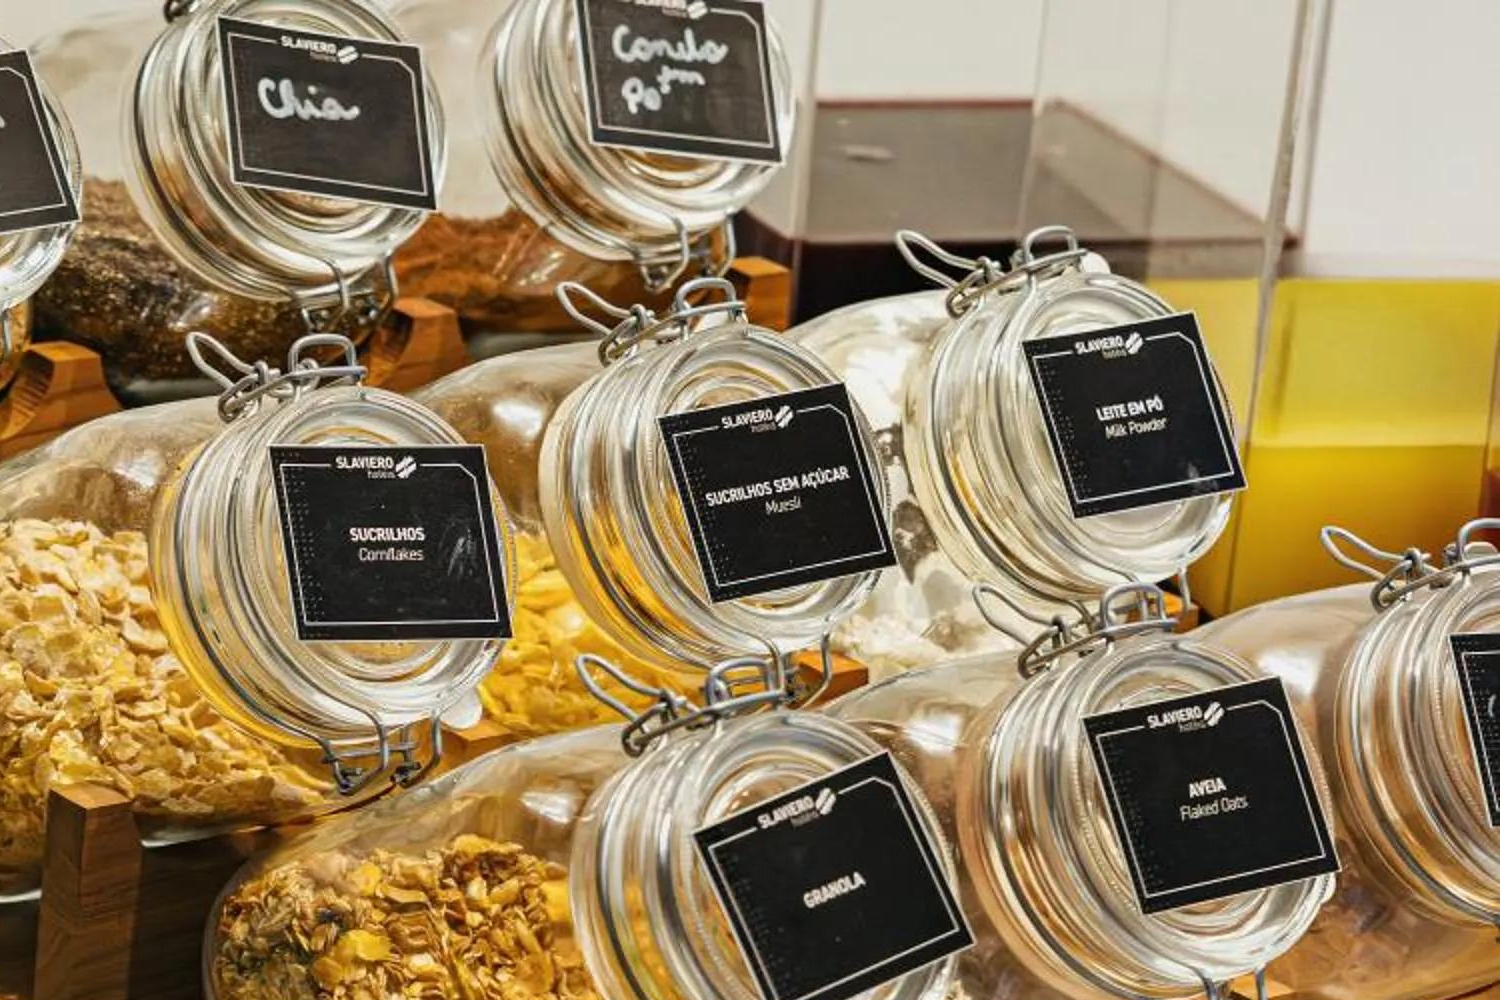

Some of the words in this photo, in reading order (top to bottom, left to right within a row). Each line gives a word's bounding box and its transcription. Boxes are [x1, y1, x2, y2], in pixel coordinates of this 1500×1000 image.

[257, 77, 361, 121] Chia
[1075, 335, 1125, 355] SLAVIERO
[1096, 403, 1127, 421] LEITE
[1129, 399, 1145, 416] EM
[1146, 394, 1164, 413] PÓ
[721, 408, 774, 430] SLAVIERO
[1105, 423, 1127, 439] Milk
[1129, 417, 1167, 436] Powder
[335, 455, 395, 470] SLAVIERO
[705, 481, 771, 508] SUCRILHOS
[773, 475, 800, 496] SEM
[801, 466, 851, 490] AÇÚCAR
[349, 527, 426, 542] SUCRILHOS
[358, 547, 425, 562] Cornflakes
[1147, 705, 1203, 729] SLAVIERO
[1188, 777, 1227, 799] AVEIA
[757, 796, 814, 829] SLAVIERO
[1179, 803, 1219, 822] Flaked
[803, 871, 867, 909] GRANOLA
